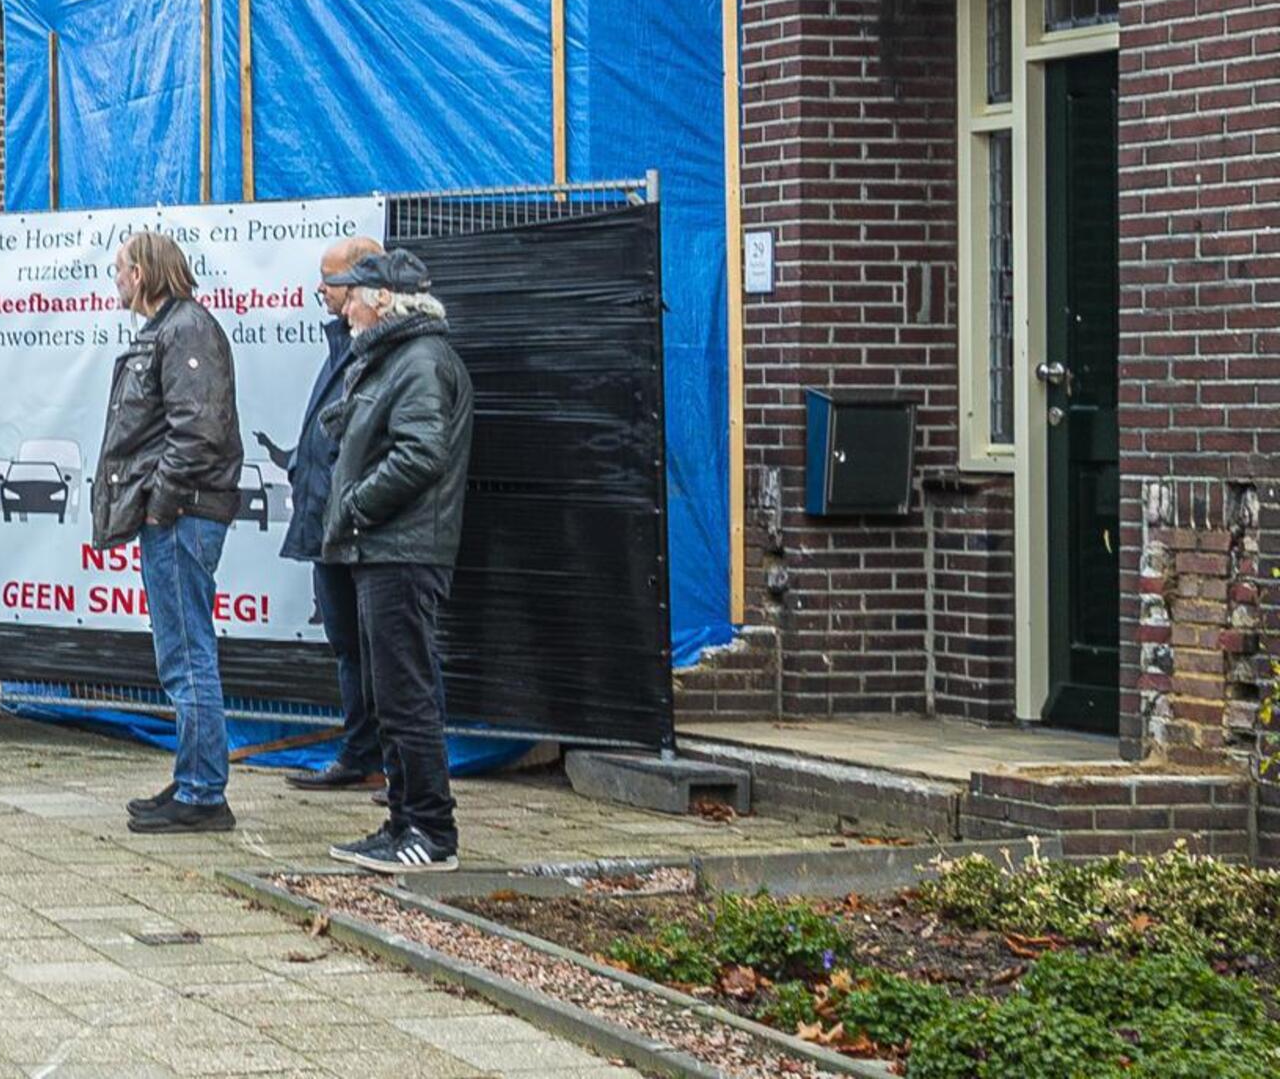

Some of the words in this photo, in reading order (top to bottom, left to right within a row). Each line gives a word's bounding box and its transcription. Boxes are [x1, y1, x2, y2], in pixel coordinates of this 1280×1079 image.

[25, 228, 83, 249] Horst
[210, 225, 238, 242] en
[247, 215, 357, 242] Provincie
[752, 240, 765, 258] 29
[17, 259, 98, 282] ruzieën
[196, 286, 305, 315] eiligheid
[92, 323, 109, 345] is
[231, 321, 266, 344] dat
[2, 581, 76, 612] GEEN
